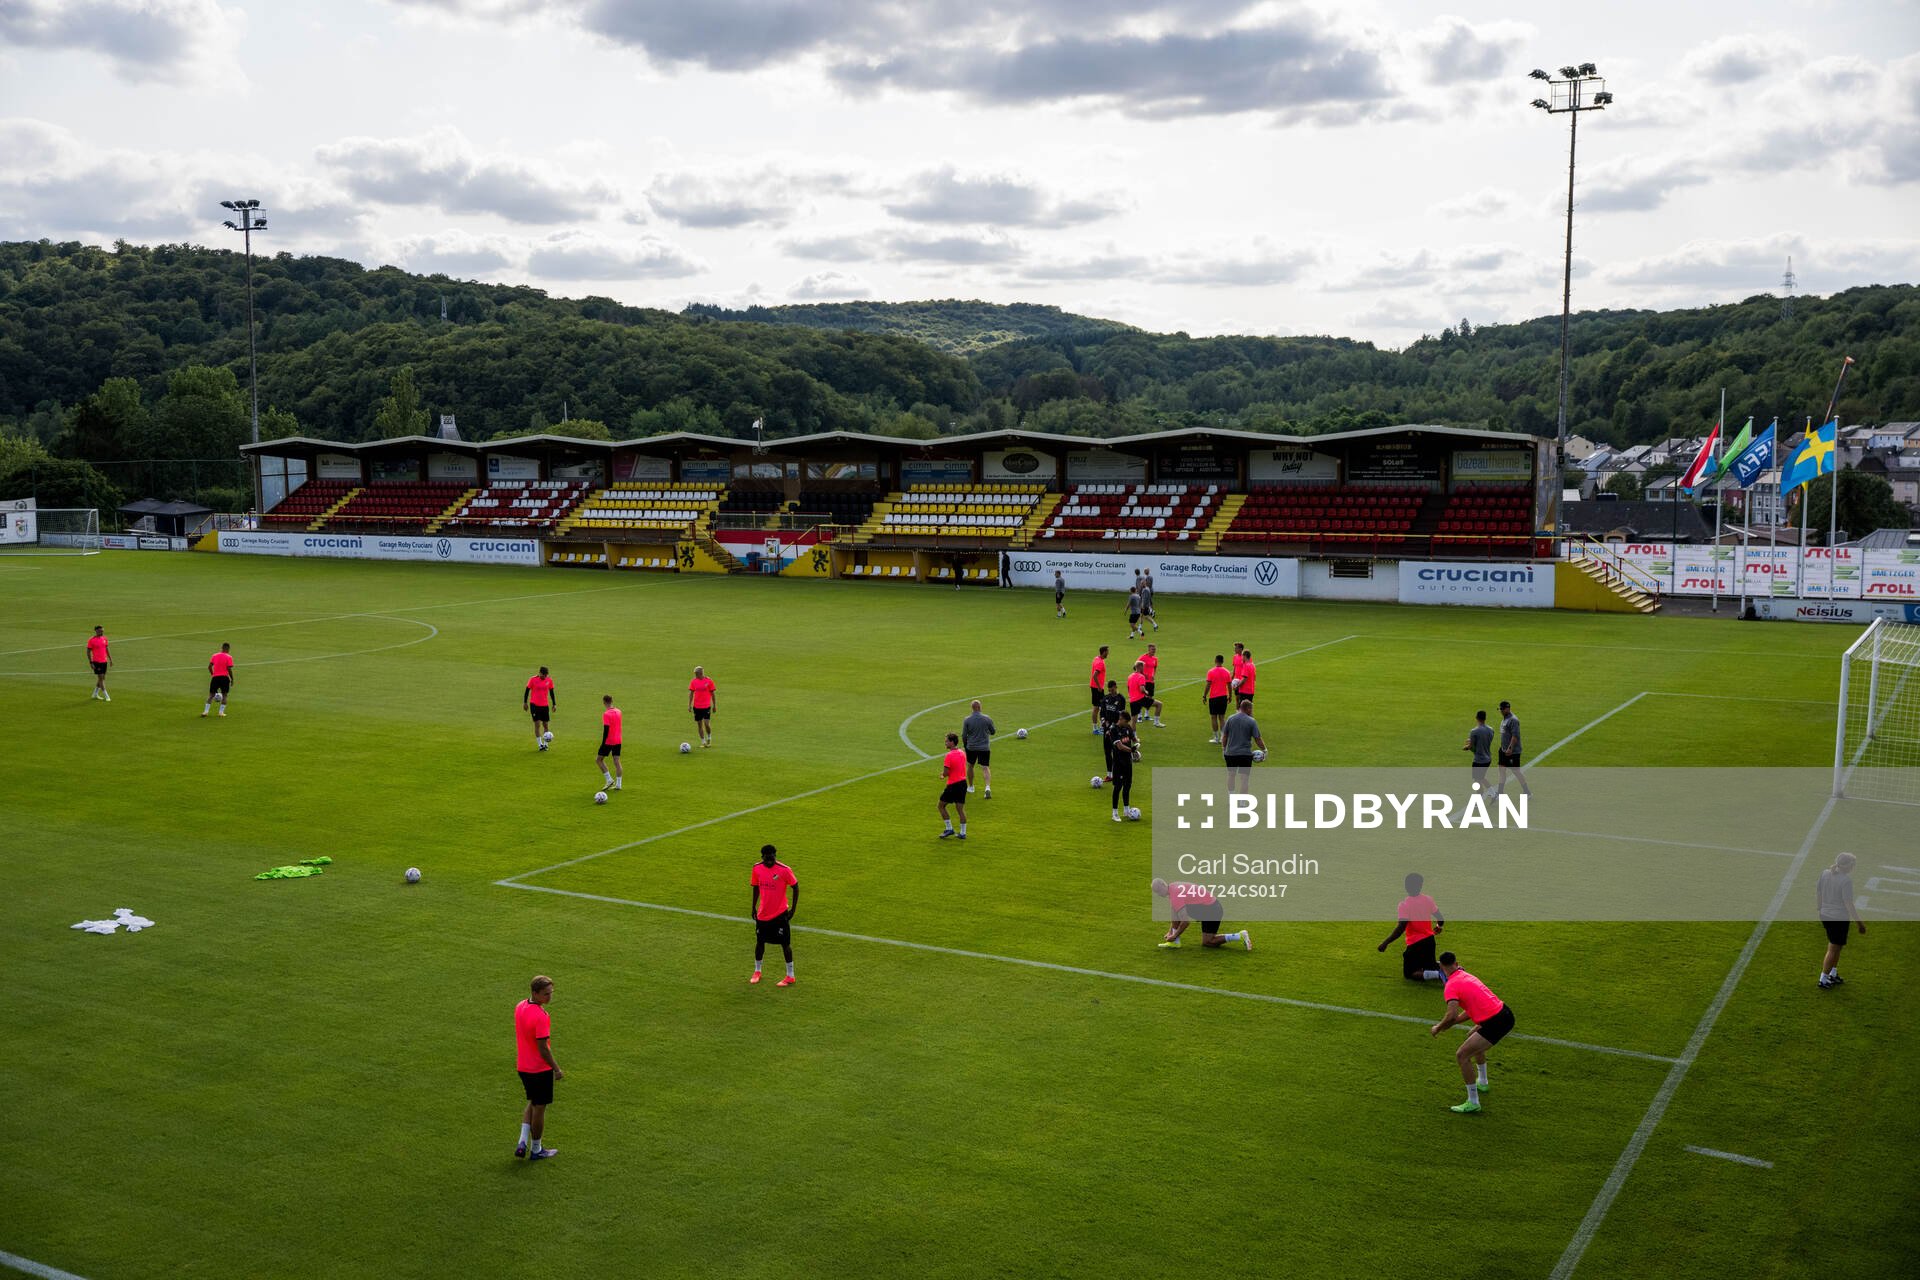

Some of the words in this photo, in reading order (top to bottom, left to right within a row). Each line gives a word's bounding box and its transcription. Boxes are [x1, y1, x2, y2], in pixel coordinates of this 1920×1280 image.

[1273, 452, 1293, 461] WHY
[1294, 452, 1313, 461] NOT
[304, 537, 363, 548] cruciani
[378, 541, 397, 549] Garage
[398, 541, 411, 549] Roby
[469, 540, 535, 552] cruciani
[1624, 545, 1667, 555] STOLL
[1045, 560, 1072, 569] Garage
[1074, 561, 1094, 569] Roby
[1160, 562, 1190, 573] Garage
[1191, 563, 1212, 573] Roby
[1214, 564, 1248, 573] Cruciani
[1417, 566, 1534, 583] cruciani
[1417, 584, 1534, 593] automobiles
[1867, 583, 1915, 594] STOLL
